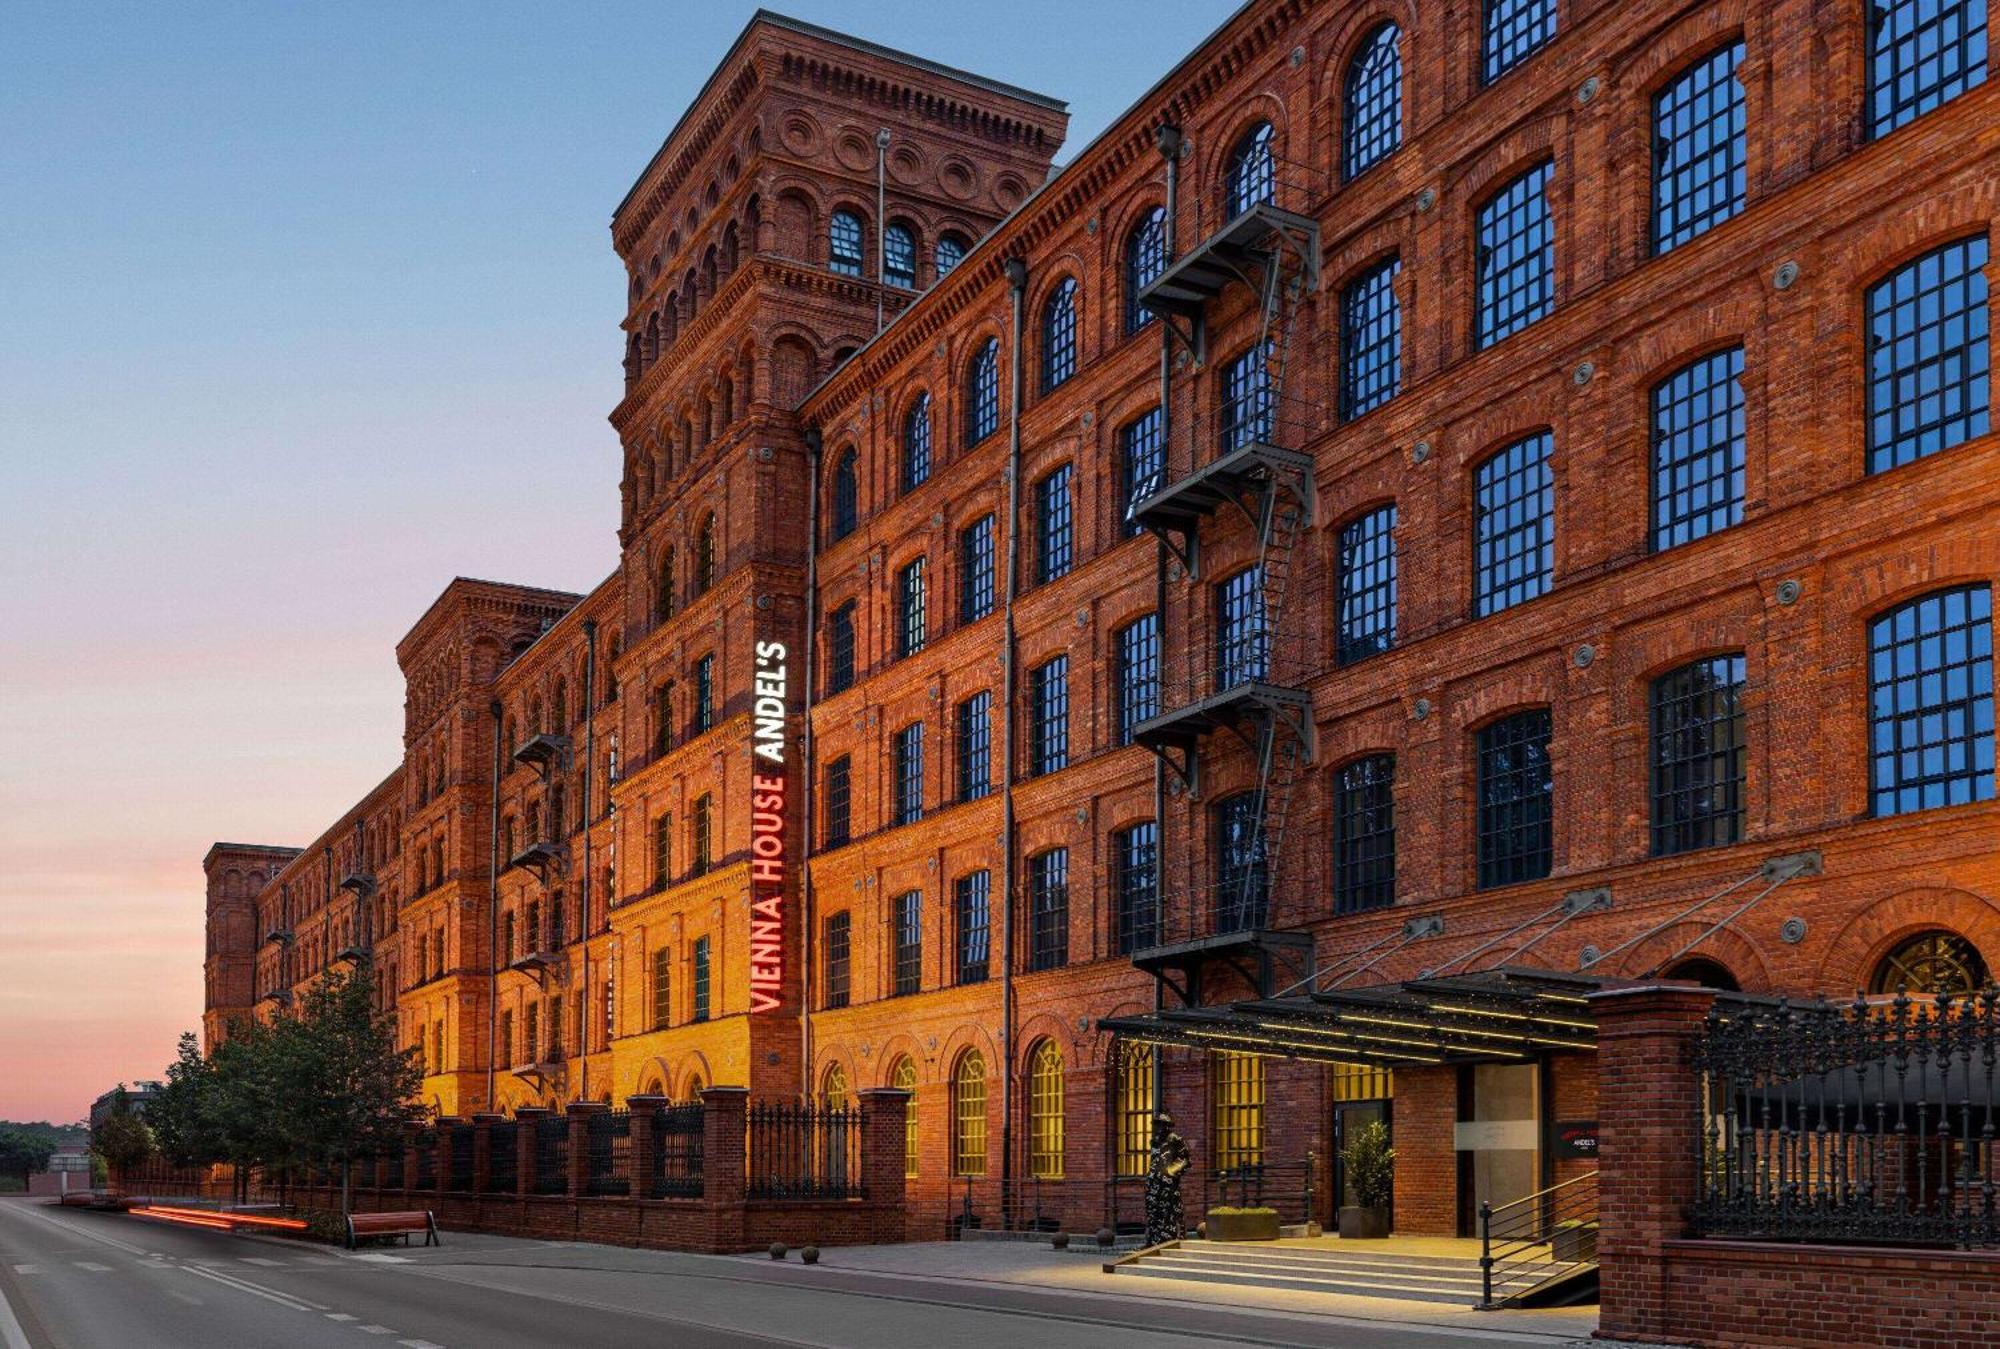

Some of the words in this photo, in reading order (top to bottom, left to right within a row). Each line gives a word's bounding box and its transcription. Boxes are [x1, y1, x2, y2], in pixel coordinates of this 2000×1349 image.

[754, 640, 786, 763] ANDEL'S
[752, 775, 783, 881] HOUSE
[751, 896, 782, 1014] VIENNA
